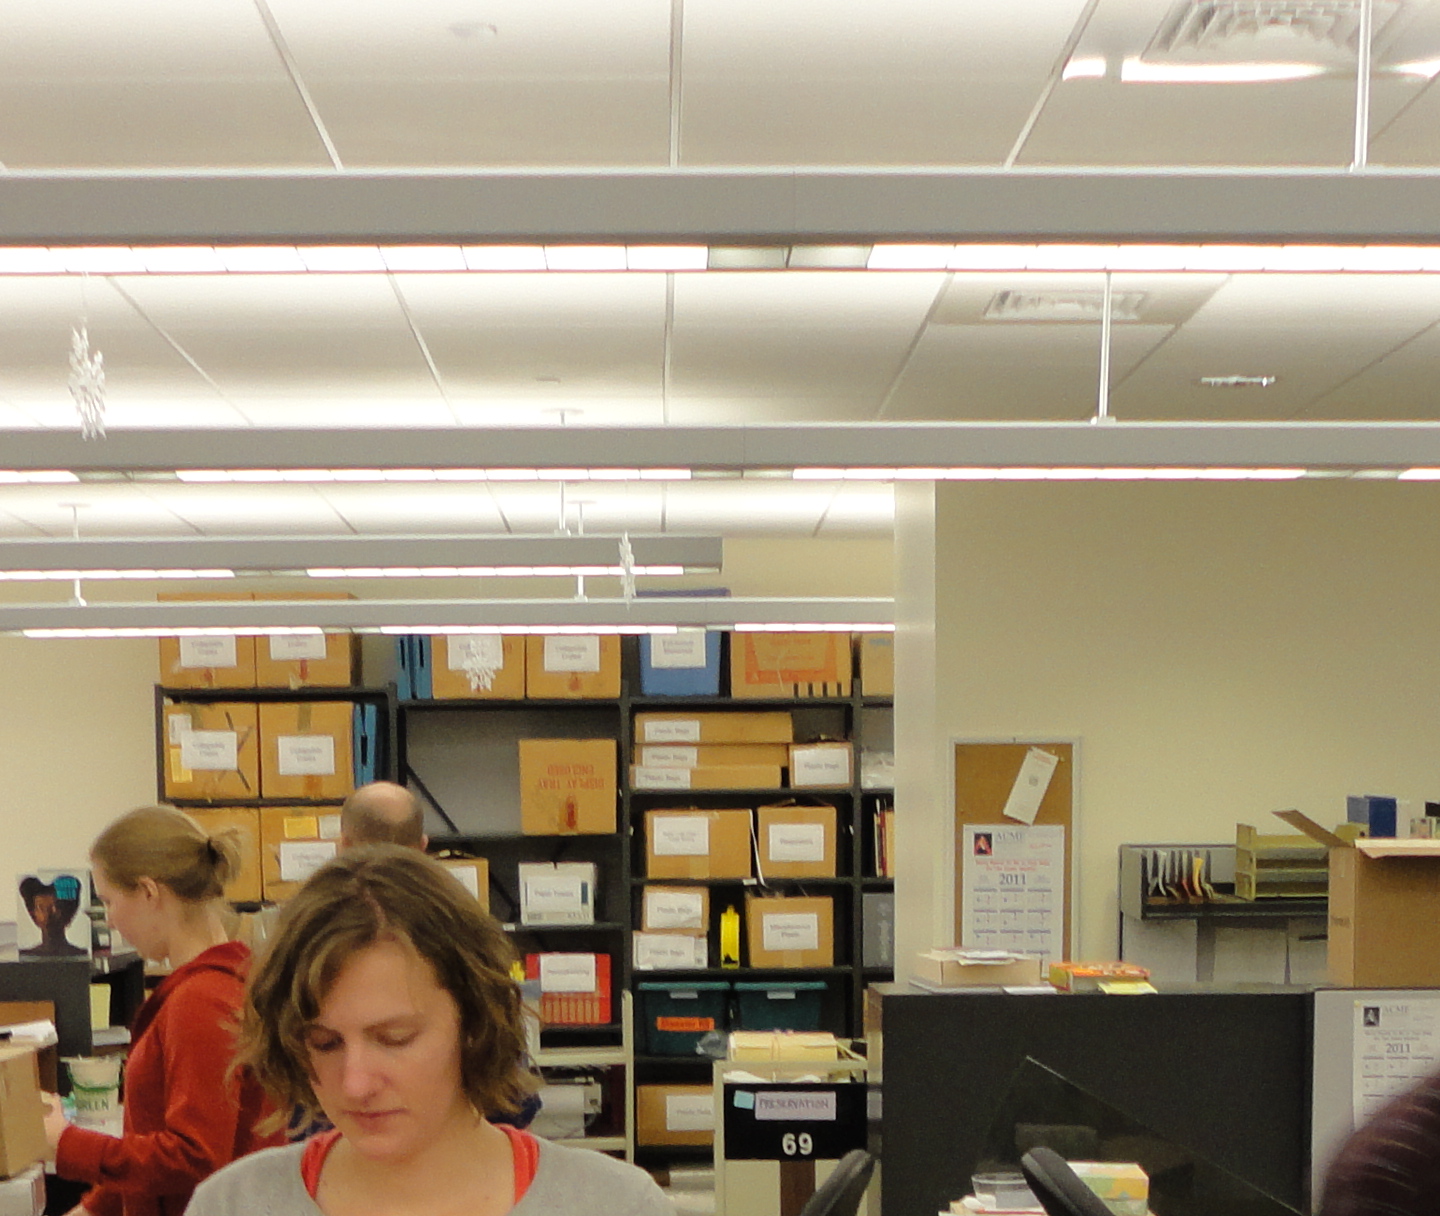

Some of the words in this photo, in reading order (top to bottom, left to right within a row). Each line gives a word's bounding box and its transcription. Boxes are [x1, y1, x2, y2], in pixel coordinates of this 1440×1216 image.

[998, 873, 1027, 885] 2011
[1386, 1043, 1411, 1053] 2011
[758, 1098, 830, 1110] PRESERVATION
[782, 1132, 813, 1156] 69
